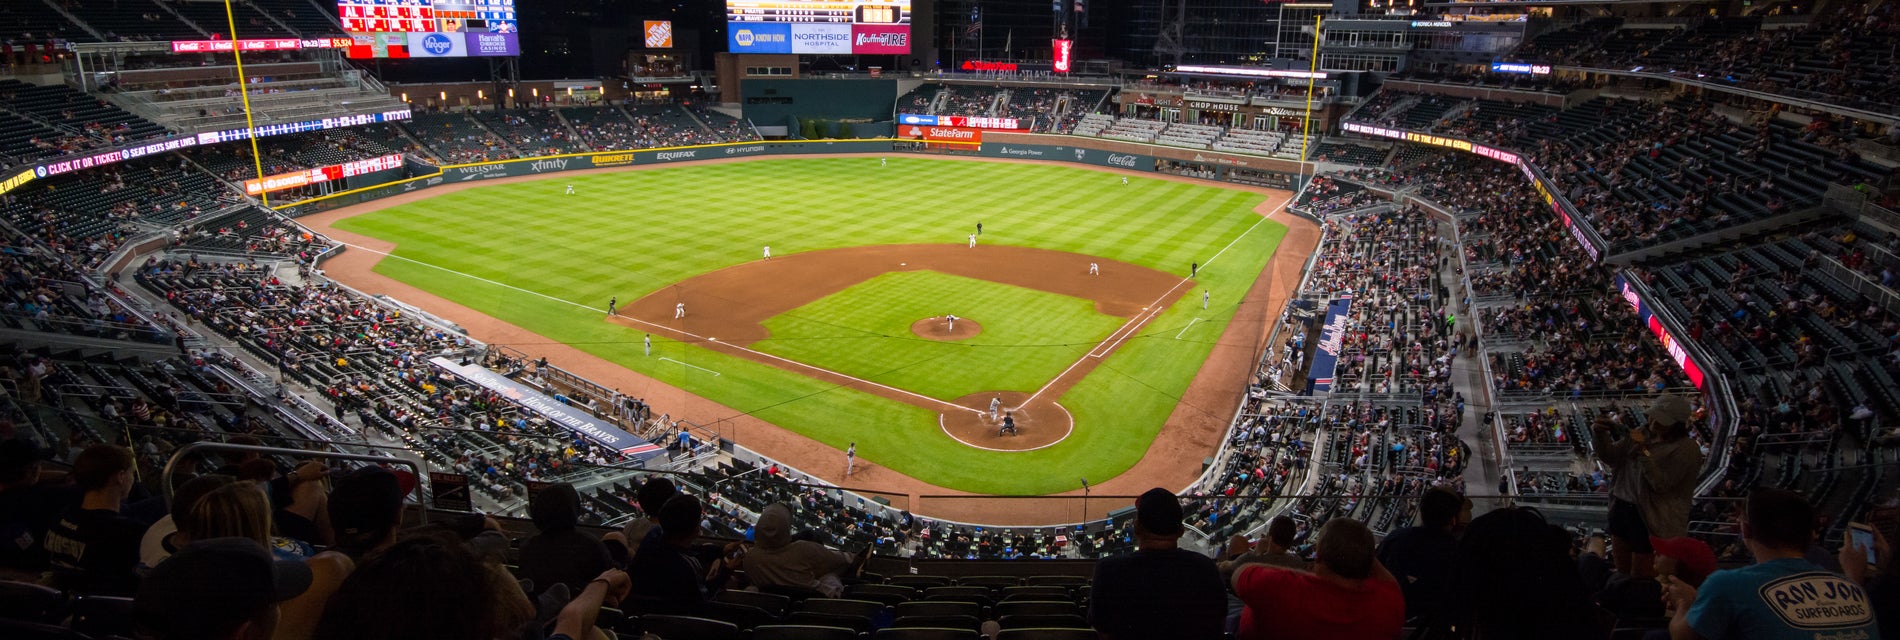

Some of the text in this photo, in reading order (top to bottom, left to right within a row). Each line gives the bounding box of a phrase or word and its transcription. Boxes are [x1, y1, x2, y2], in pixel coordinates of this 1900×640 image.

[345, 6, 358, 17] AL
[66, 42, 77, 52] 42
[425, 36, 450, 53] Kroger
[880, 33, 907, 47] TIRE
[1348, 124, 1360, 132] SEAT
[1360, 125, 1374, 134] BELTS
[1374, 126, 1386, 136] SAVE
[1386, 128, 1400, 138] LIVES
[1414, 134, 1420, 142] IS
[1420, 134, 1432, 144] THE
[1432, 136, 1445, 146] LAW
[1446, 138, 1452, 147] IN
[1478, 146, 1489, 156] CLICK
[49, 160, 72, 174] CLICK
[73, 158, 80, 169] IT
[82, 156, 93, 168] OR
[94, 152, 122, 166] TICKET!
[130, 148, 146, 158] SEAT
[147, 144, 164, 154] BELTS
[165, 141, 180, 150] SAVE
[180, 137, 196, 148] LIVES
[592, 154, 634, 164] QUIKRETE
[656, 150, 696, 161] EQUIFAX
[459, 164, 505, 174] WELLSTAR
[531, 158, 568, 172] xfinity
[276, 174, 304, 188] SOUTH
[523, 396, 553, 412] HOME
[561, 416, 583, 426] THE
[580, 422, 620, 444] BRAVES
[1774, 581, 1865, 610] RON JON
[1795, 604, 1865, 619] SURFBOARDS
